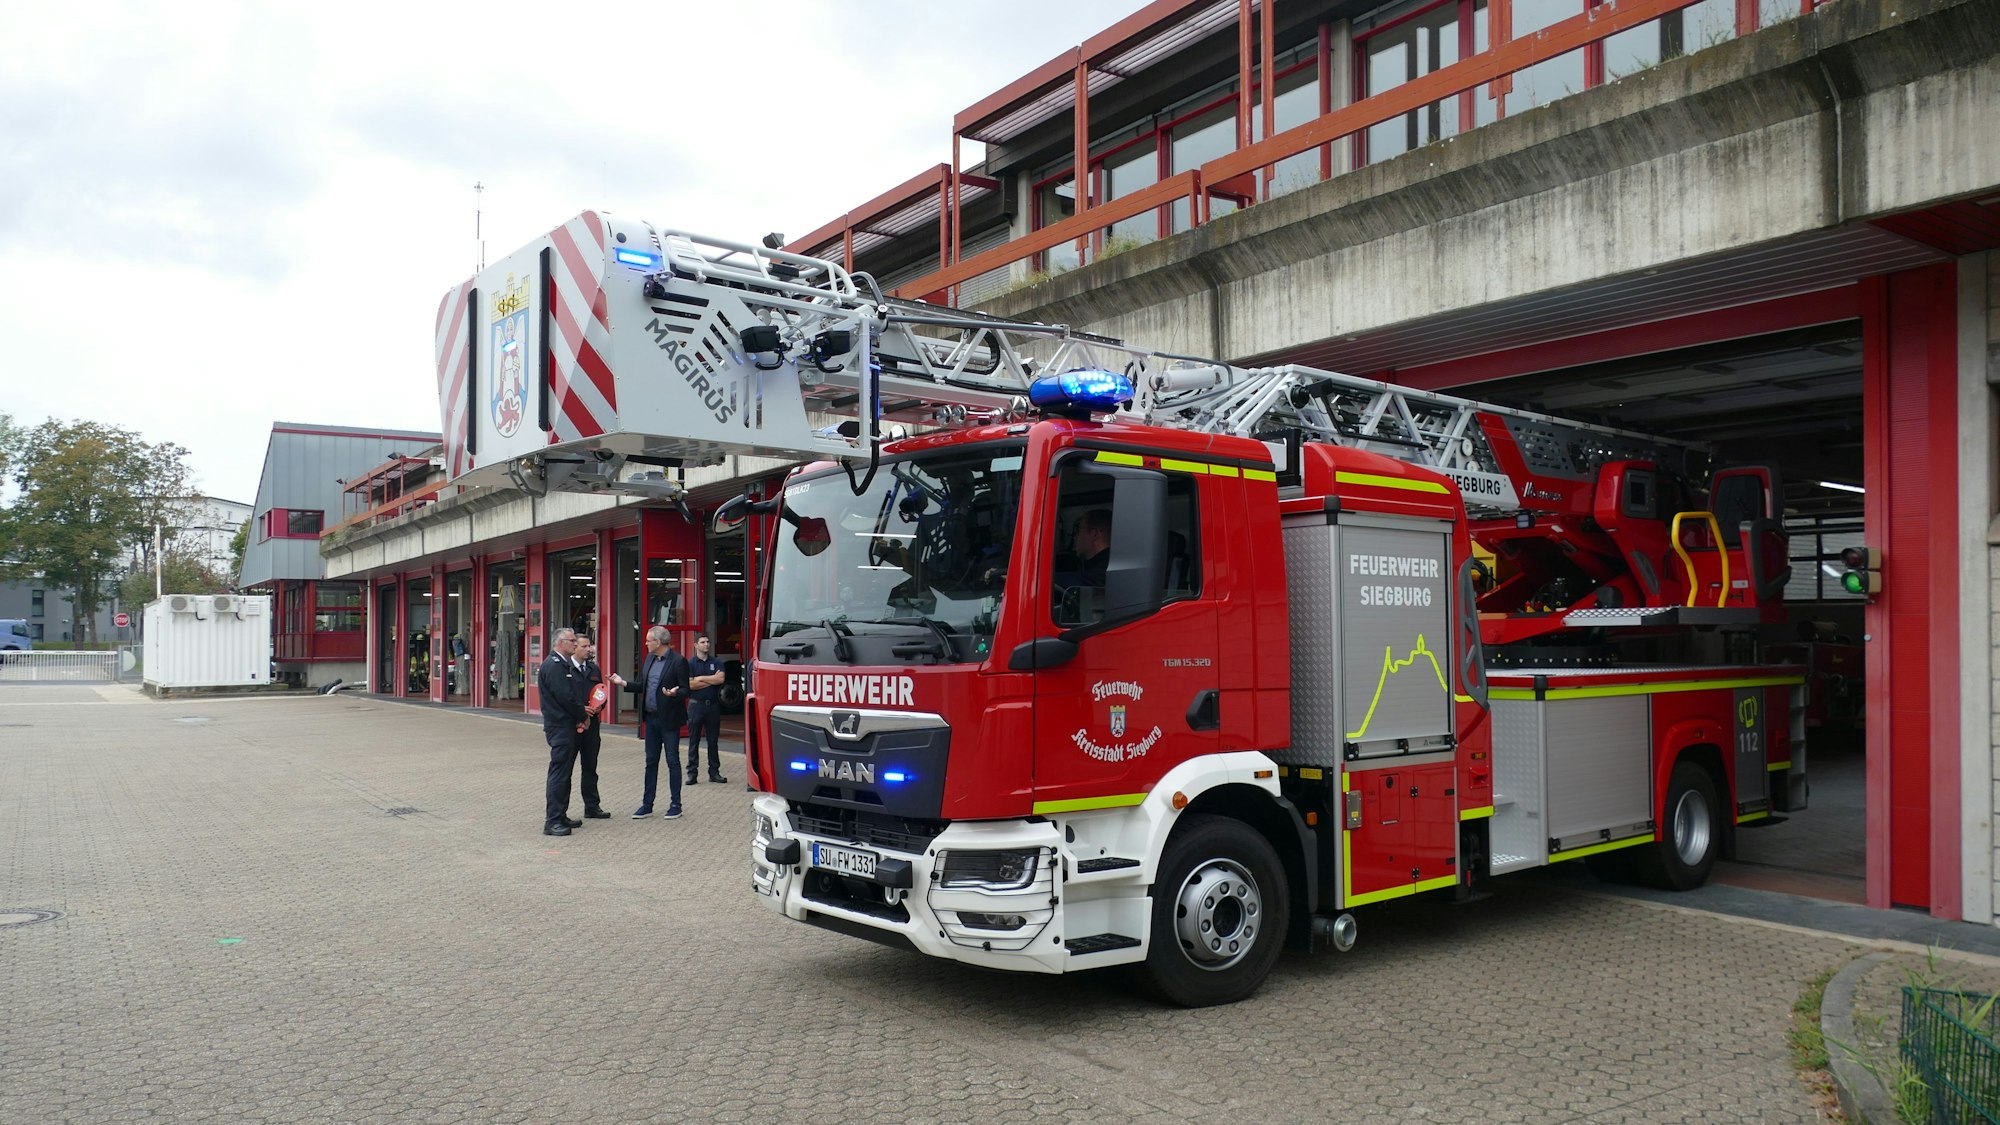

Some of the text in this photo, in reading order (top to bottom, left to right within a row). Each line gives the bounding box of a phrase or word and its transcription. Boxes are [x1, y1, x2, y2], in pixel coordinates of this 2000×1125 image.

[645, 317, 733, 424] MAGIRUS
[1445, 474, 1501, 496] EGBURG
[1350, 554, 1439, 578] FEUERWEHR
[1360, 585, 1432, 607] SIEGBURG
[1162, 658, 1211, 667] TGM 15.320
[787, 673, 915, 706] FEUERWEHR
[1092, 680, 1144, 701] Feuerwehr
[1071, 725, 1162, 762] Kreisstadt Siegburg
[1740, 732, 1758, 753] 112
[818, 758, 875, 784] MAN
[820, 848, 876, 875] SU FW 1331
